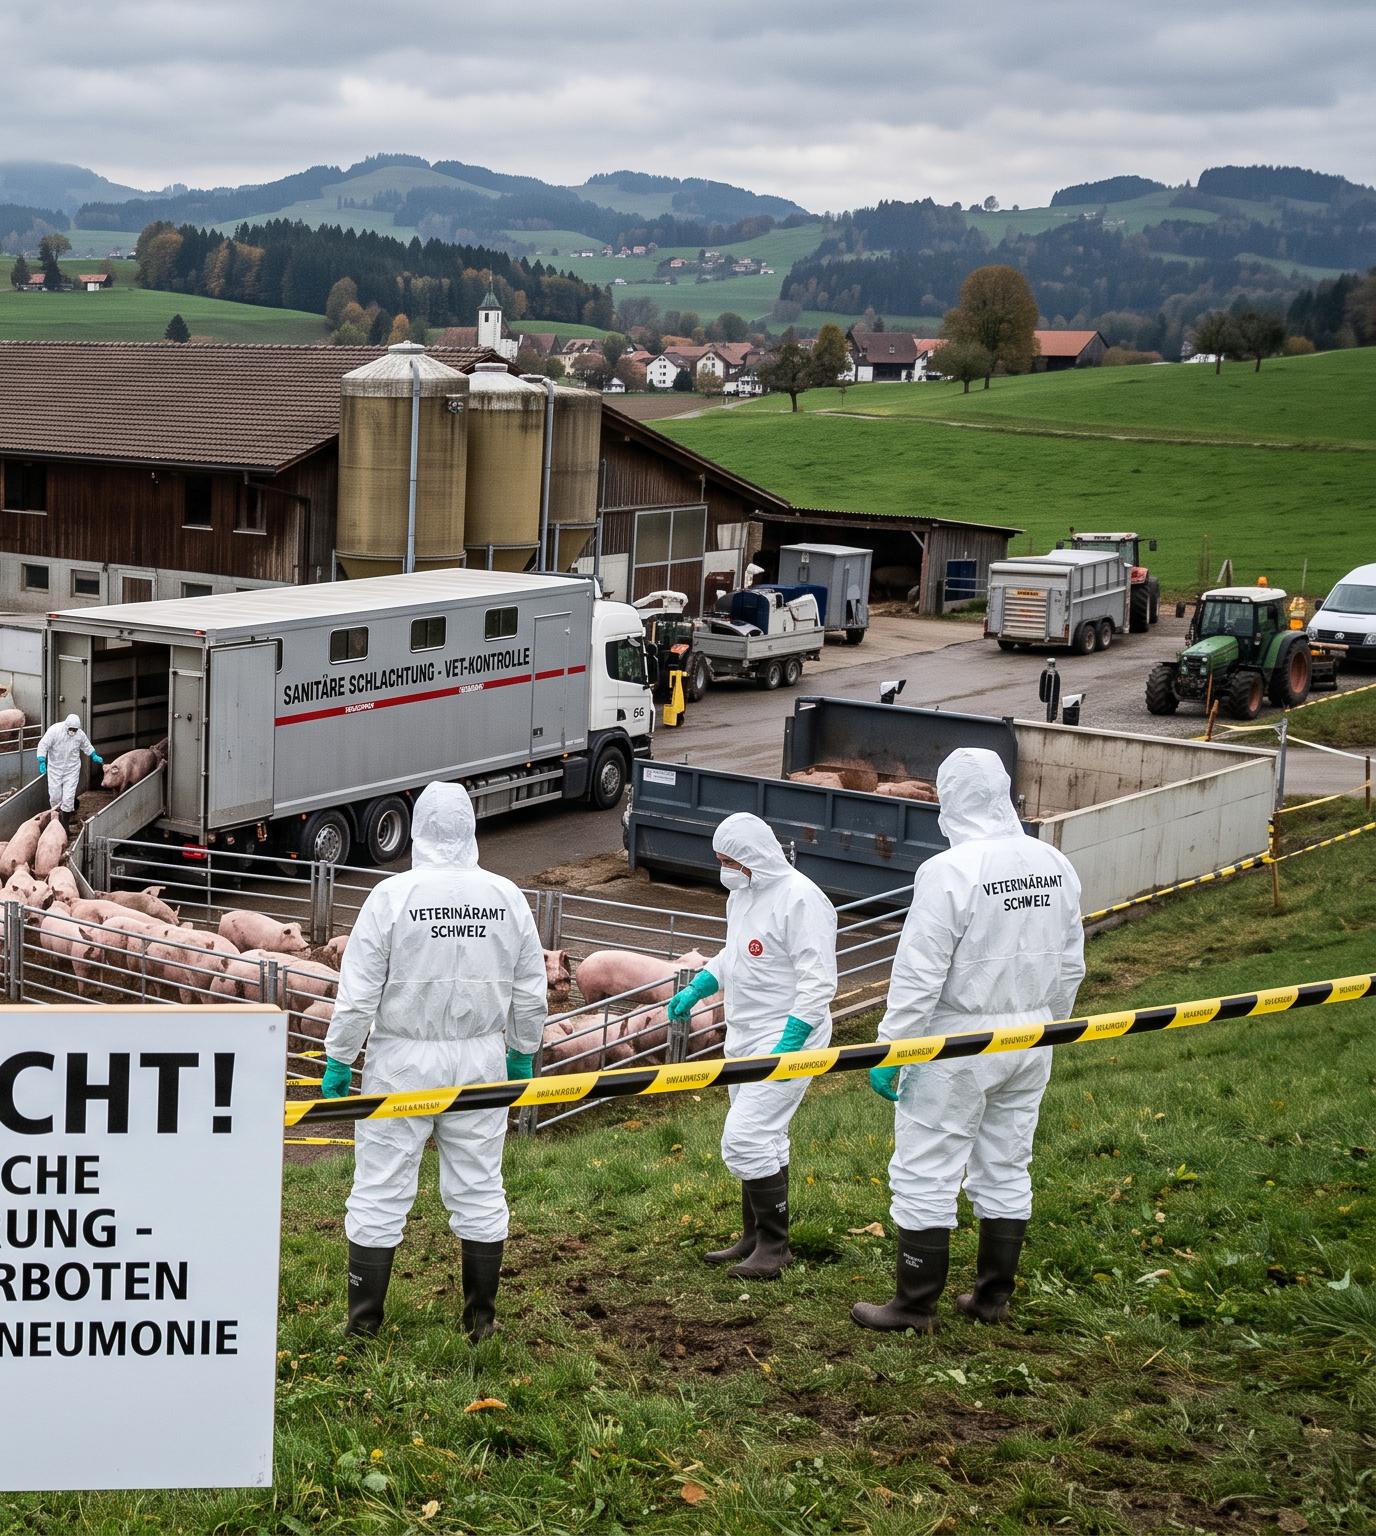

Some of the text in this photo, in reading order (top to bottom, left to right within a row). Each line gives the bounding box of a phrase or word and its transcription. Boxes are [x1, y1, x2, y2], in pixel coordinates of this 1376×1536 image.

[284, 674, 346, 706] SANITÄRE
[348, 662, 435, 694] SCHLACHTUNG
[444, 647, 530, 679] VET-KONTROLLE
[982, 873, 1063, 896] VETERINÄRAMT
[1003, 894, 1051, 912] SCHWEIZ
[408, 904, 506, 922] VETERINÄRAMT
[430, 925, 487, 939] SCHWEIZ
